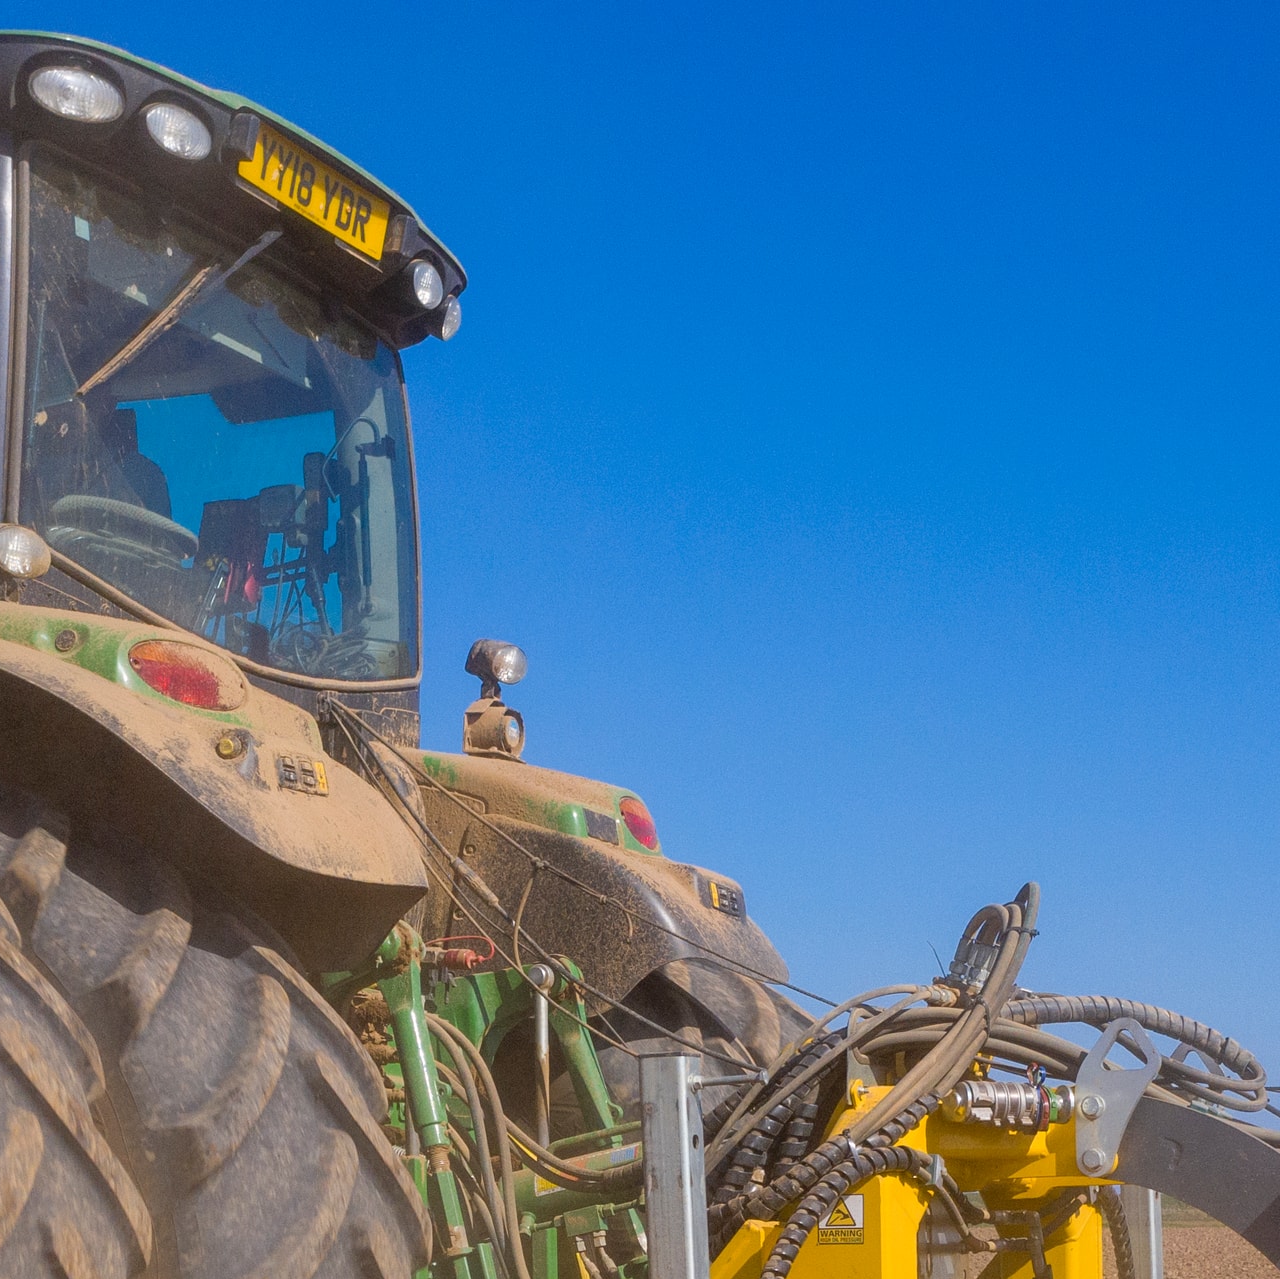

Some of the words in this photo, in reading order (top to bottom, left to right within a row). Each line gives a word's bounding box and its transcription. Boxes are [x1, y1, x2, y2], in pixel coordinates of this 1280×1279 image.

[260, 134, 316, 208] YY18
[323, 174, 372, 244] YDR
[820, 1230, 862, 1238] WARNING
